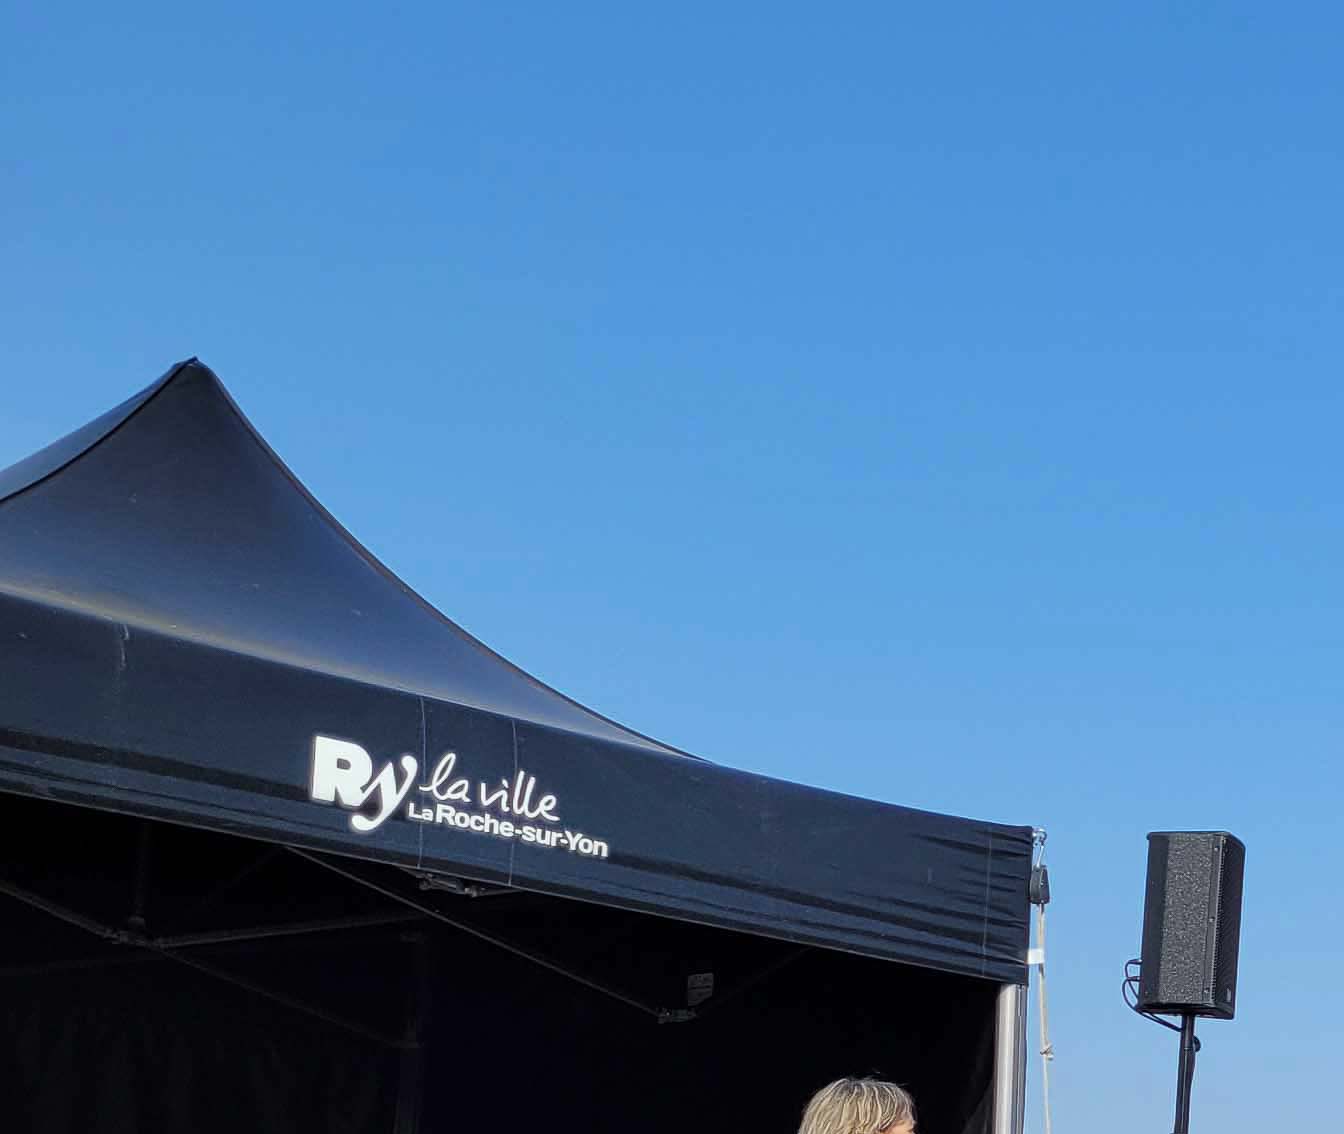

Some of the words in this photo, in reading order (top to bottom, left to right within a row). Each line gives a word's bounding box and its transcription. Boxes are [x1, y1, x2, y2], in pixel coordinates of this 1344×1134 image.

[312, 736, 418, 830] Ry
[419, 752, 471, 803] la
[480, 769, 560, 822] ville
[408, 803, 434, 822] La
[435, 804, 608, 858] Roche-sur-Yon
